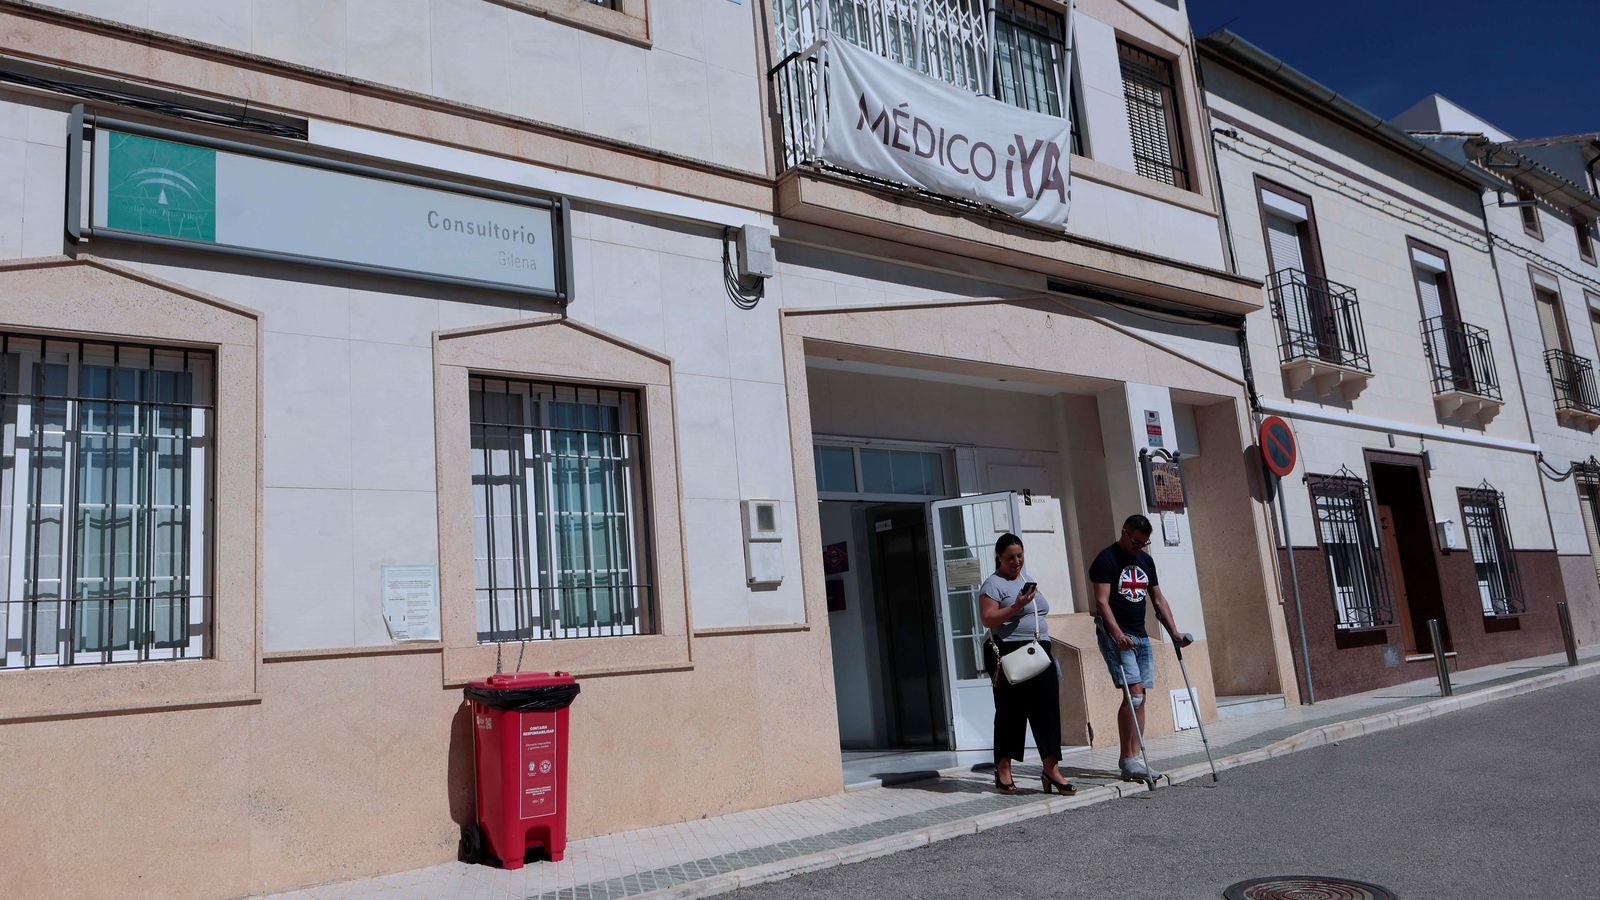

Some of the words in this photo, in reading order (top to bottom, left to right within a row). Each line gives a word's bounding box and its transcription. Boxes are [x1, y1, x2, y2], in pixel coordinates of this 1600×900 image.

[856, 92, 997, 182] MÉDICO
[427, 210, 536, 245] Consultorio
[498, 250, 537, 271] Gilena
